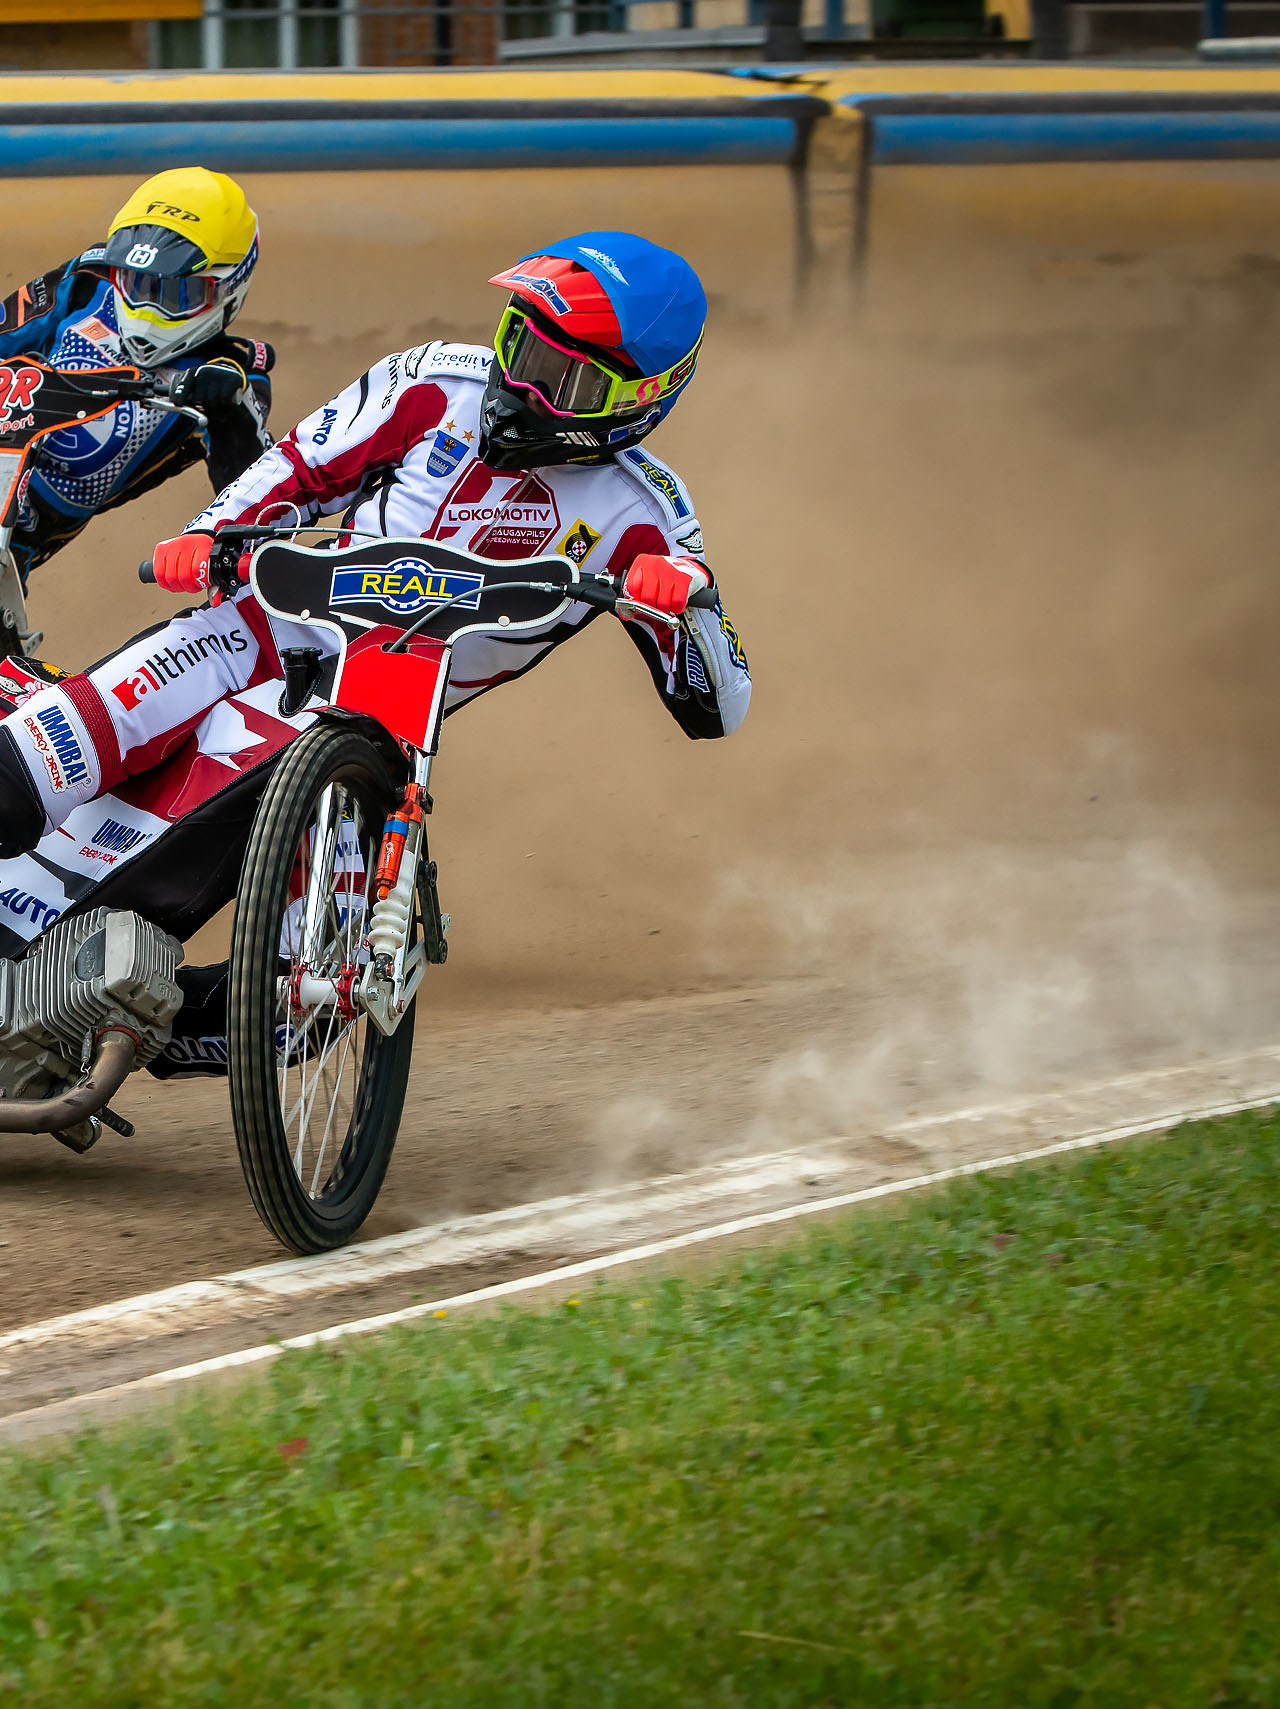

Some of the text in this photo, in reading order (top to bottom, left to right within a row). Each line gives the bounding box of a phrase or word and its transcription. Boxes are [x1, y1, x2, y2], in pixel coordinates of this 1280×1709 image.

[639, 460, 679, 504] REALL
[448, 507, 551, 522] LOKOMOTIV
[360, 573, 453, 598] REALL
[24, 717, 64, 791] ENERGY DRINK
